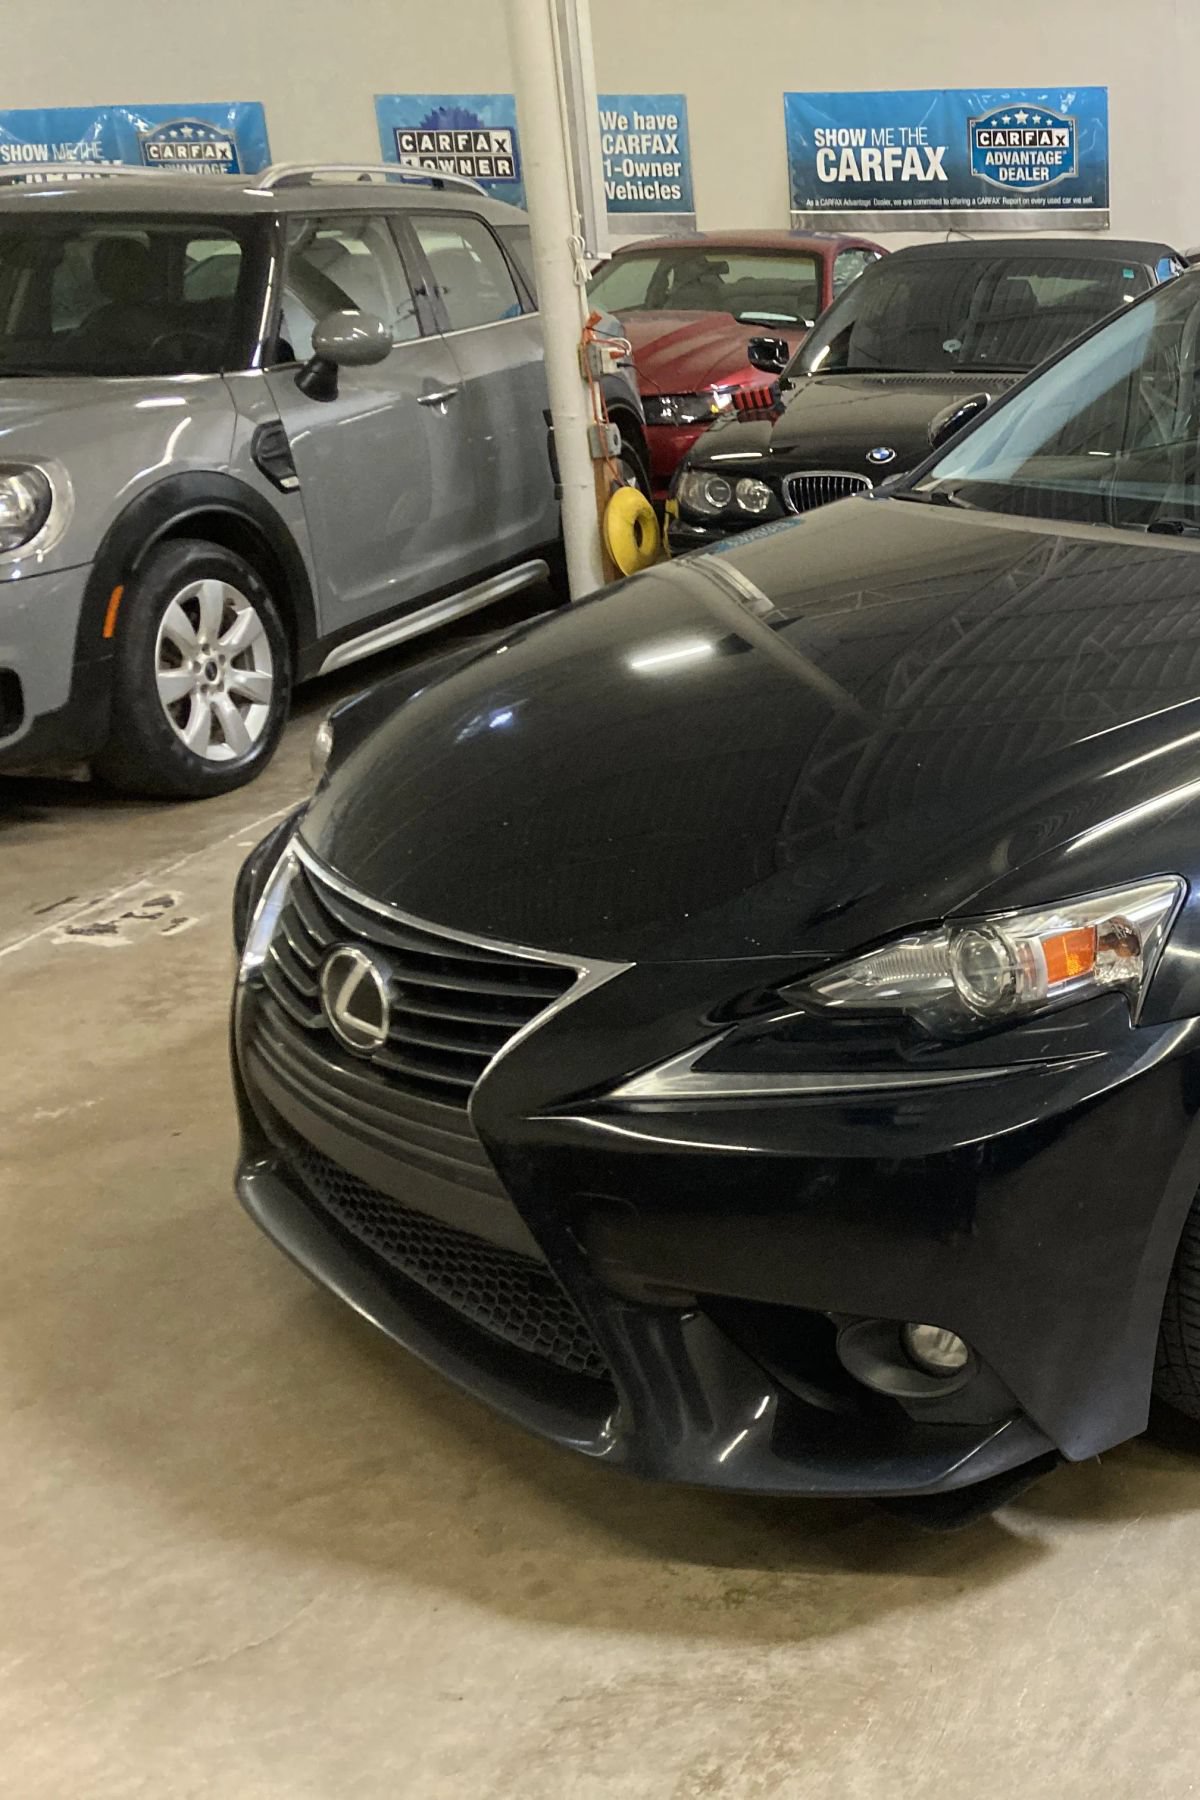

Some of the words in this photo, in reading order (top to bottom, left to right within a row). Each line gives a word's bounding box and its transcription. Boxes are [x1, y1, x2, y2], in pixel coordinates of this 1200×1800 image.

[601, 111, 628, 131] We
[633, 111, 678, 131] have
[400, 133, 511, 154] CARFAX
[601, 134, 679, 155] CARFAX
[815, 127, 867, 147] SHOW
[871, 128, 895, 146] ME
[898, 126, 928, 146] THE
[979, 130, 1067, 148] CARFAX
[1, 144, 48, 163] SHOW
[51, 144, 75, 161] ME
[78, 141, 105, 160] THE
[149, 144, 231, 161] CARFAX
[985, 150, 1063, 166] ADVANTAGE
[603, 159, 682, 178] 1-Owner
[816, 146, 948, 183] CARFAX
[999, 167, 1050, 181] DEALER
[604, 180, 682, 200] Vehicles
